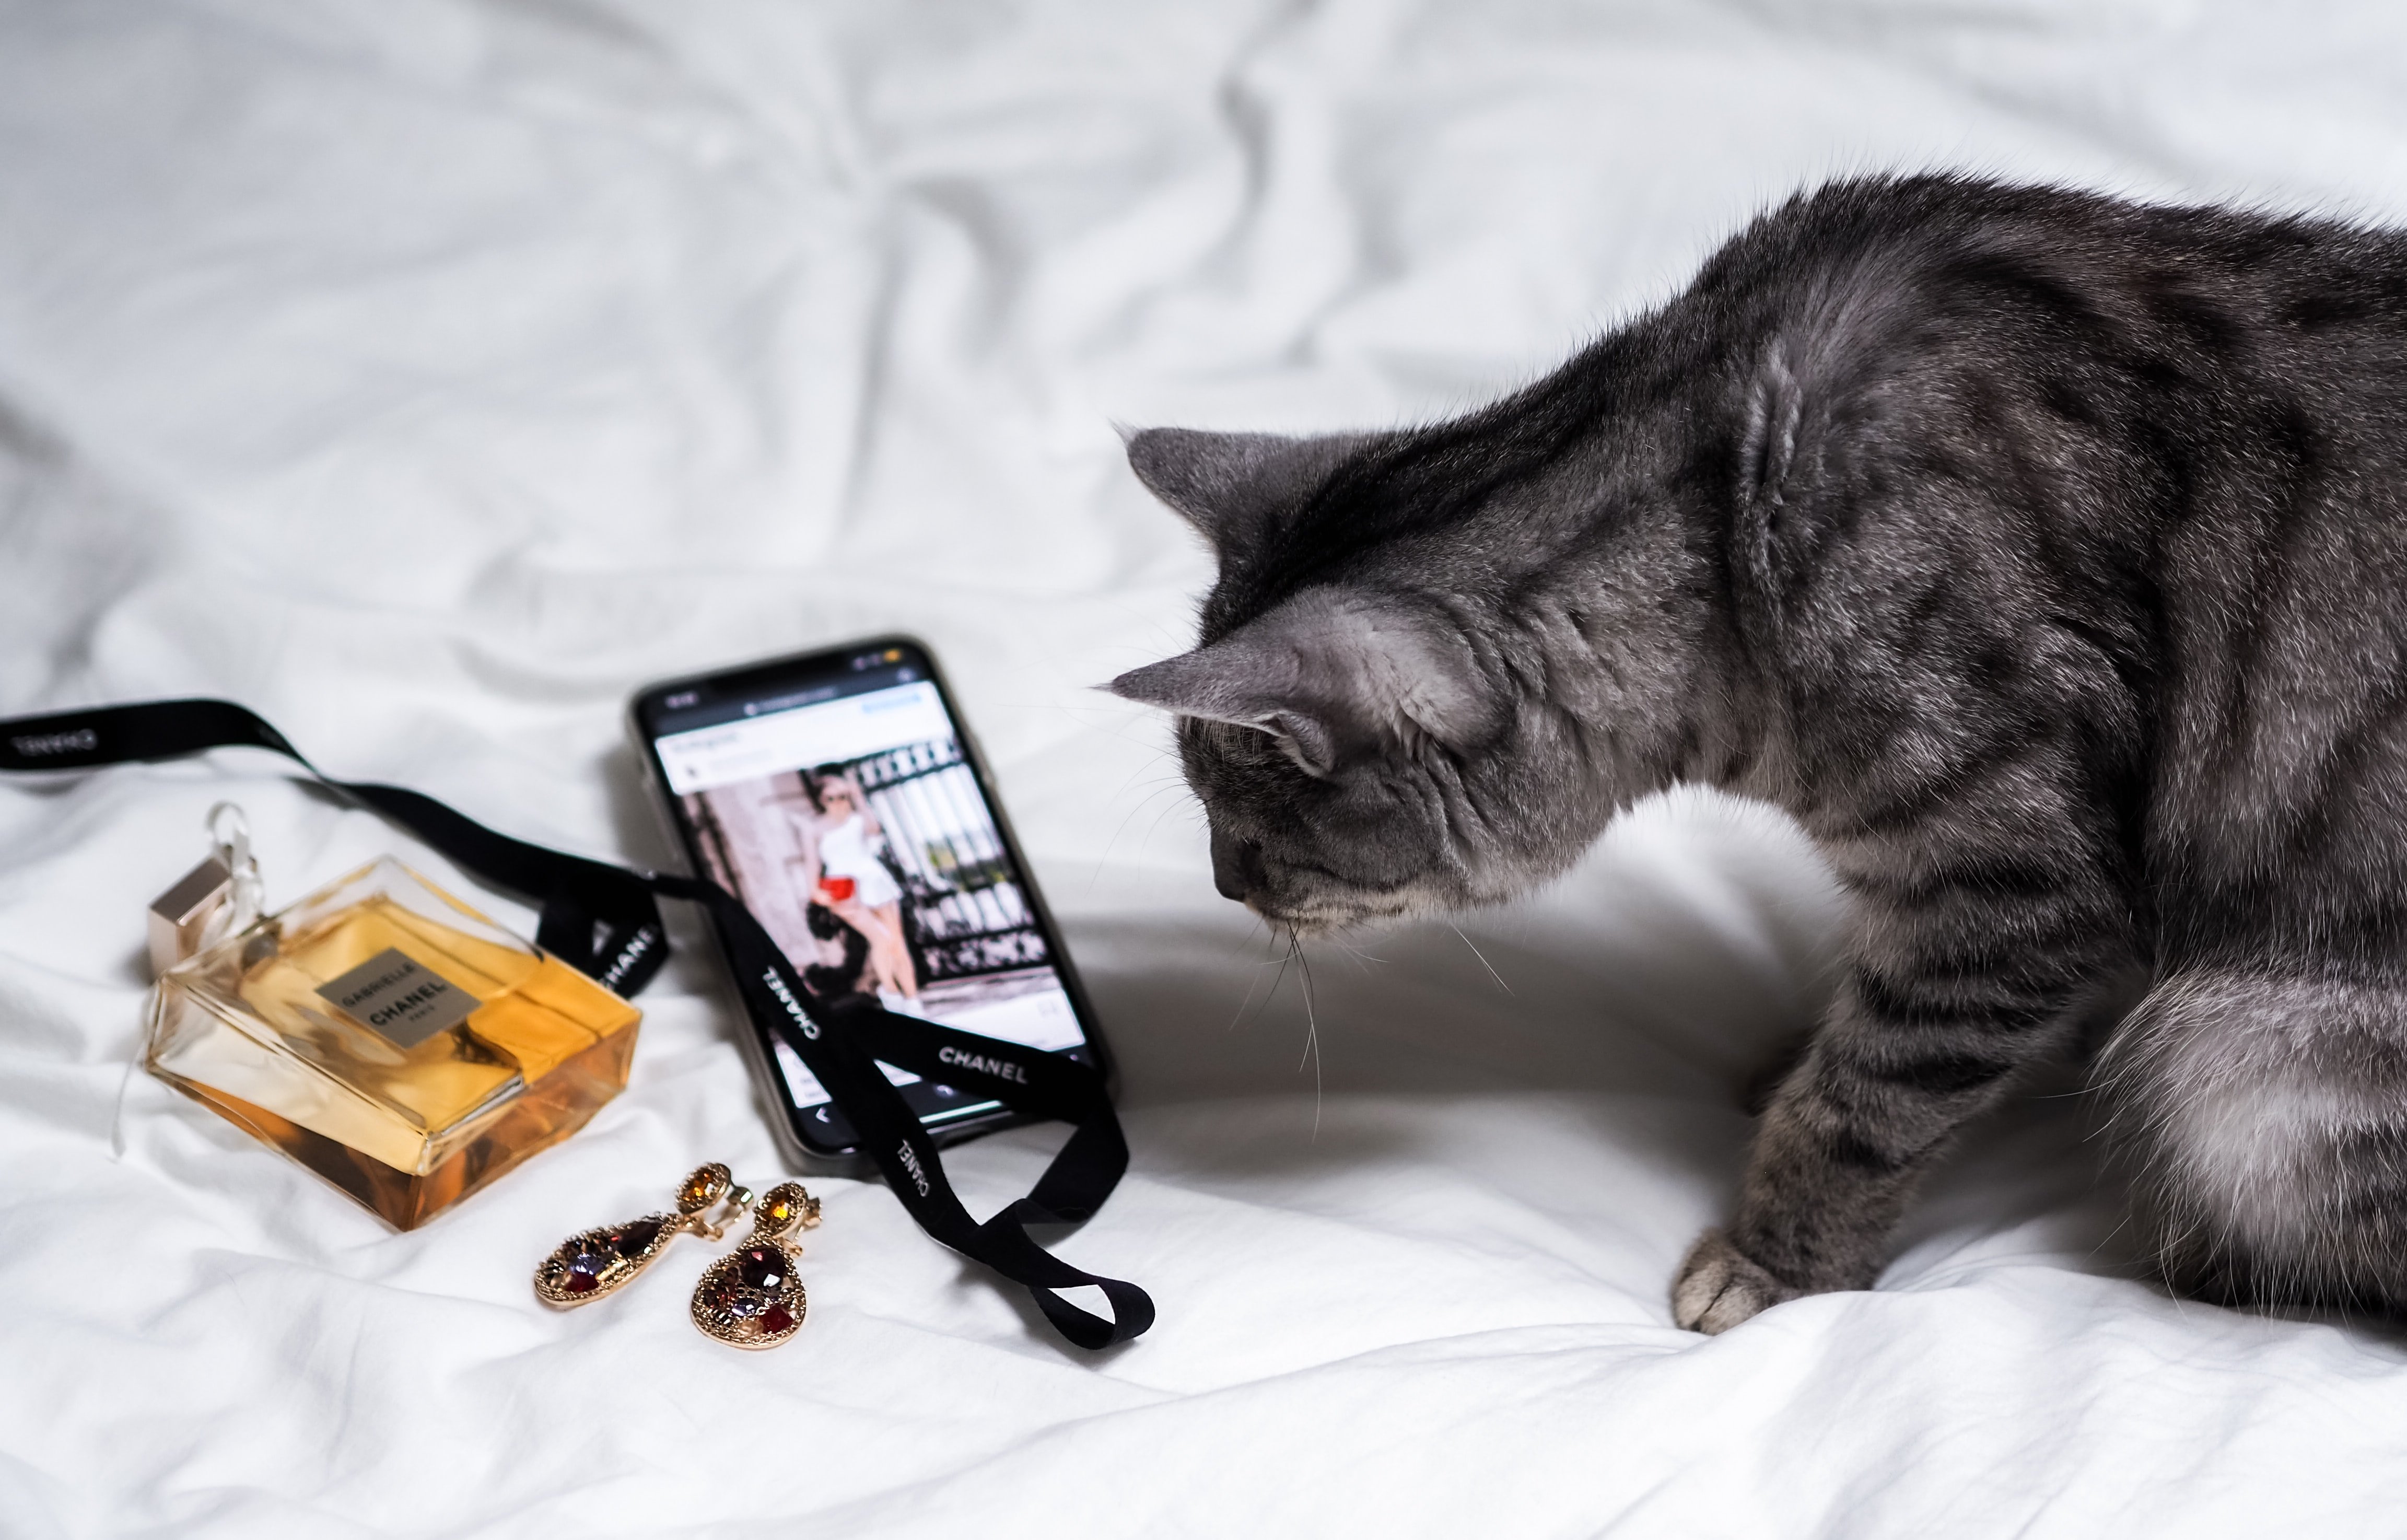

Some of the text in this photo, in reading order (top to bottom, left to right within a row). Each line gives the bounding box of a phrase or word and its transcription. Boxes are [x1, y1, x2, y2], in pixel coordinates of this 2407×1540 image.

[342, 962, 415, 1007] GABRIELLE
[369, 981, 448, 1026] CHANEL
[763, 965, 821, 1040] CHANEL
[939, 1046, 1028, 1084] CHANEL
[897, 1138, 930, 1197] CHANEL
